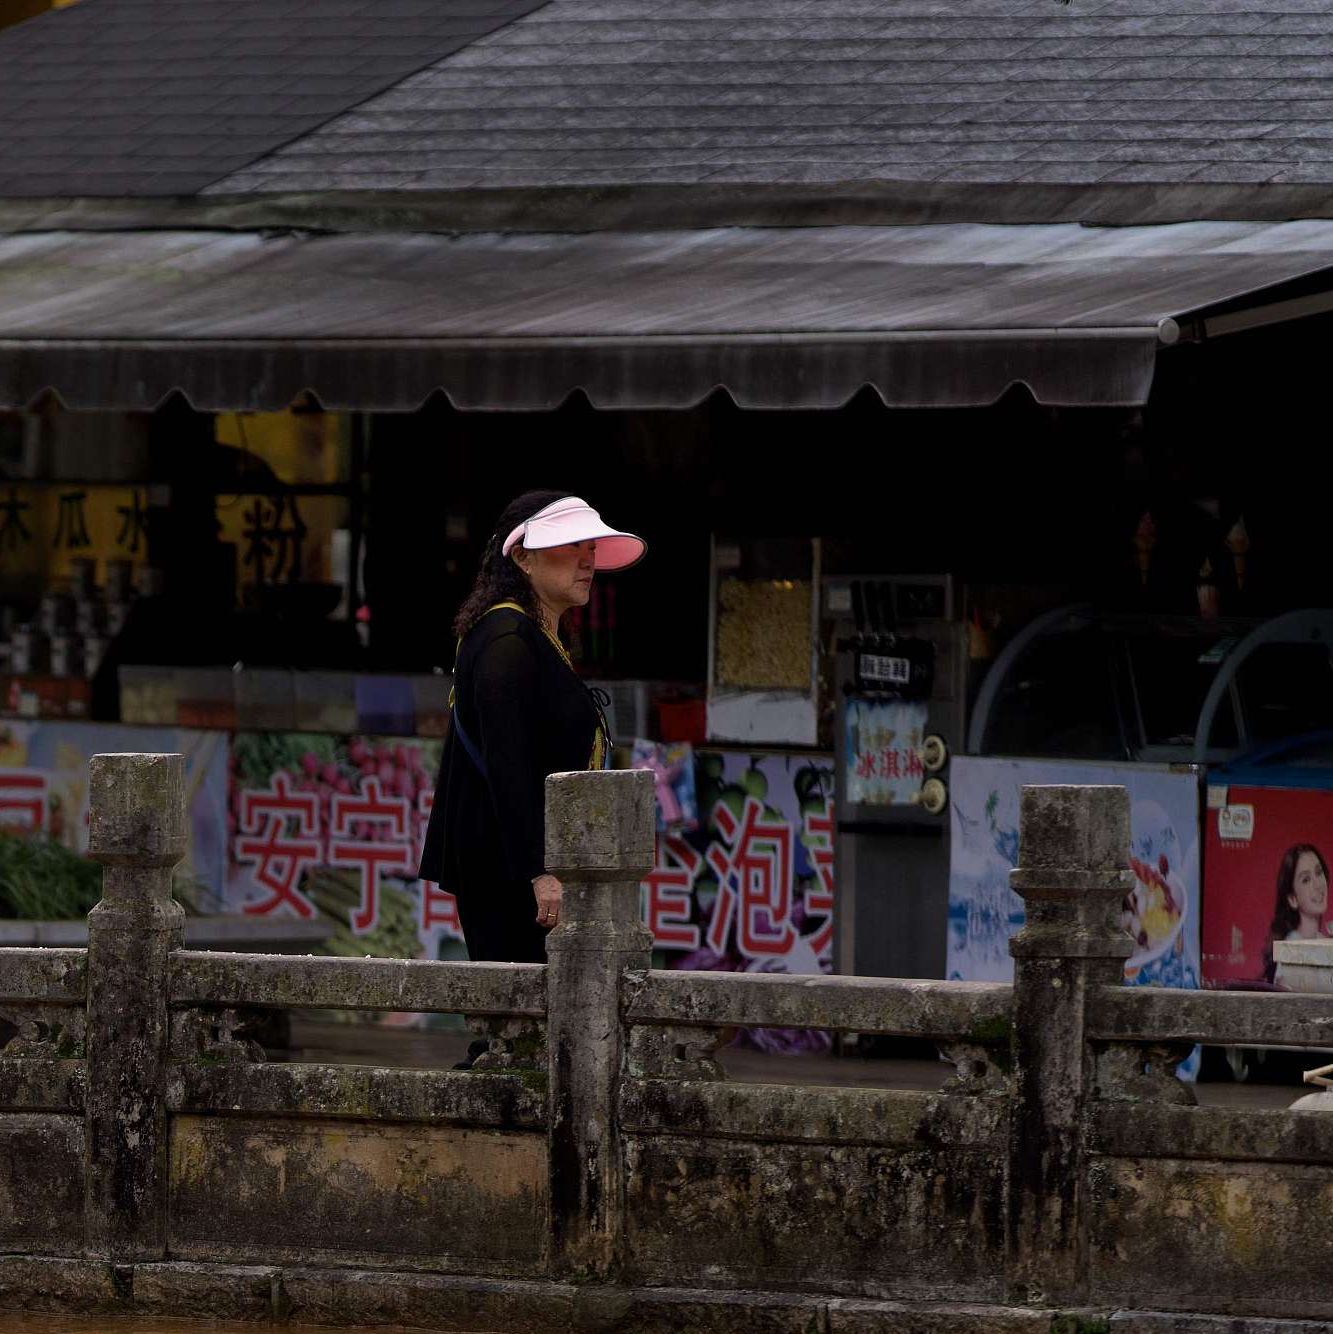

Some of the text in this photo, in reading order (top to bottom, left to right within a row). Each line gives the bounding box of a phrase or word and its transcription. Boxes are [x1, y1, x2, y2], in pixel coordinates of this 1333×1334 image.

[242, 494, 306, 585] 粉
[855, 748, 927, 778] 冰淇淋
